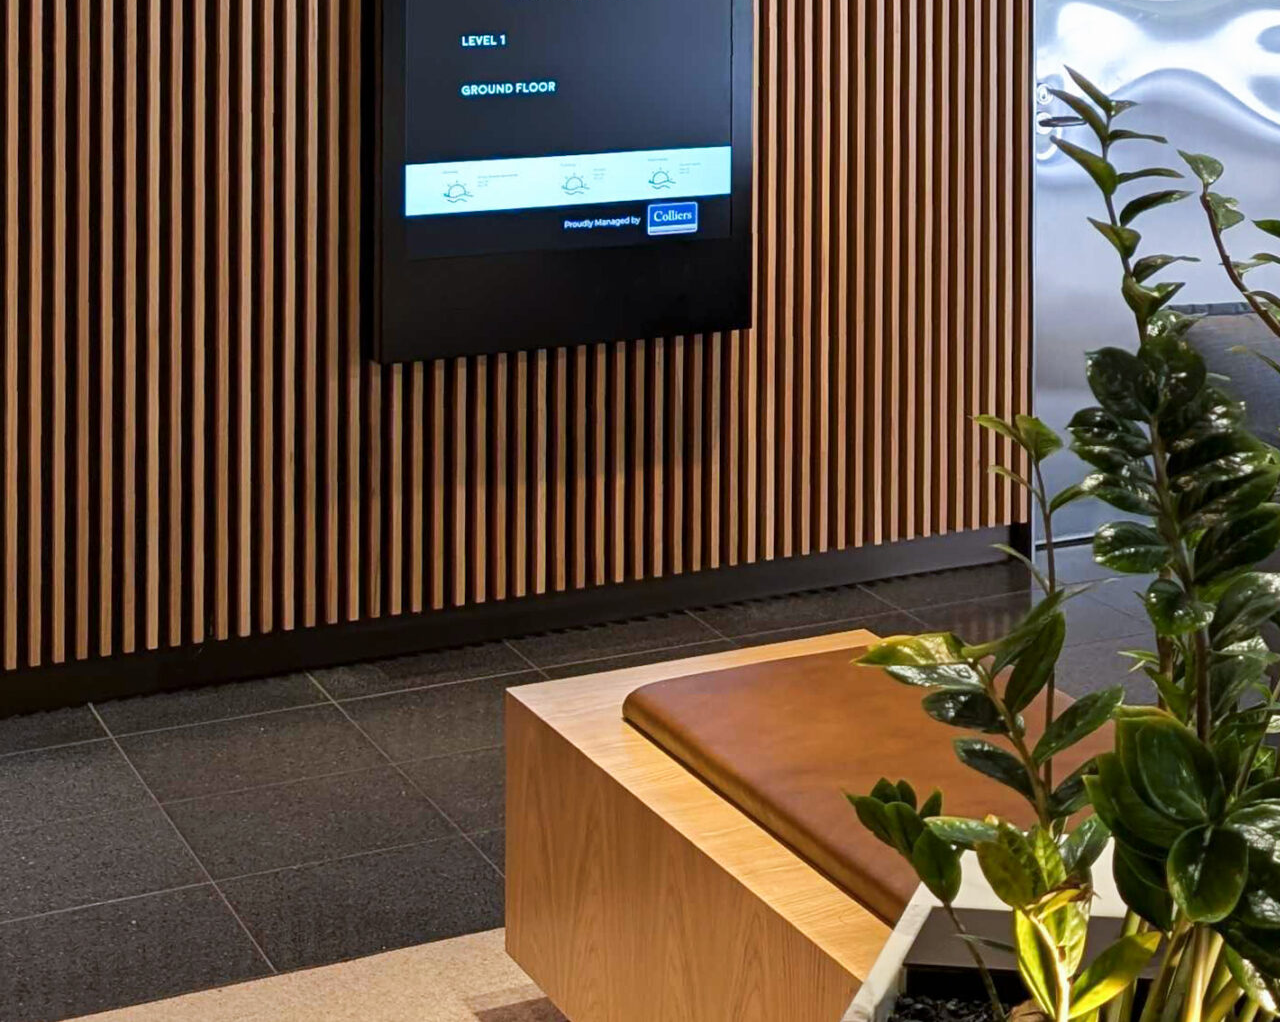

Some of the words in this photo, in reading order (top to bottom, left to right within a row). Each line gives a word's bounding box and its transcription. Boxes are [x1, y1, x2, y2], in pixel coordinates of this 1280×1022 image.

[461, 35, 498, 47] LEVEL
[499, 34, 506, 46] 1
[461, 83, 513, 96] GROUND
[515, 81, 556, 93] FLOOR
[563, 219, 593, 229] Proudly
[594, 216, 630, 228] Managed
[631, 215, 641, 225] by
[653, 209, 692, 222] Colliers
